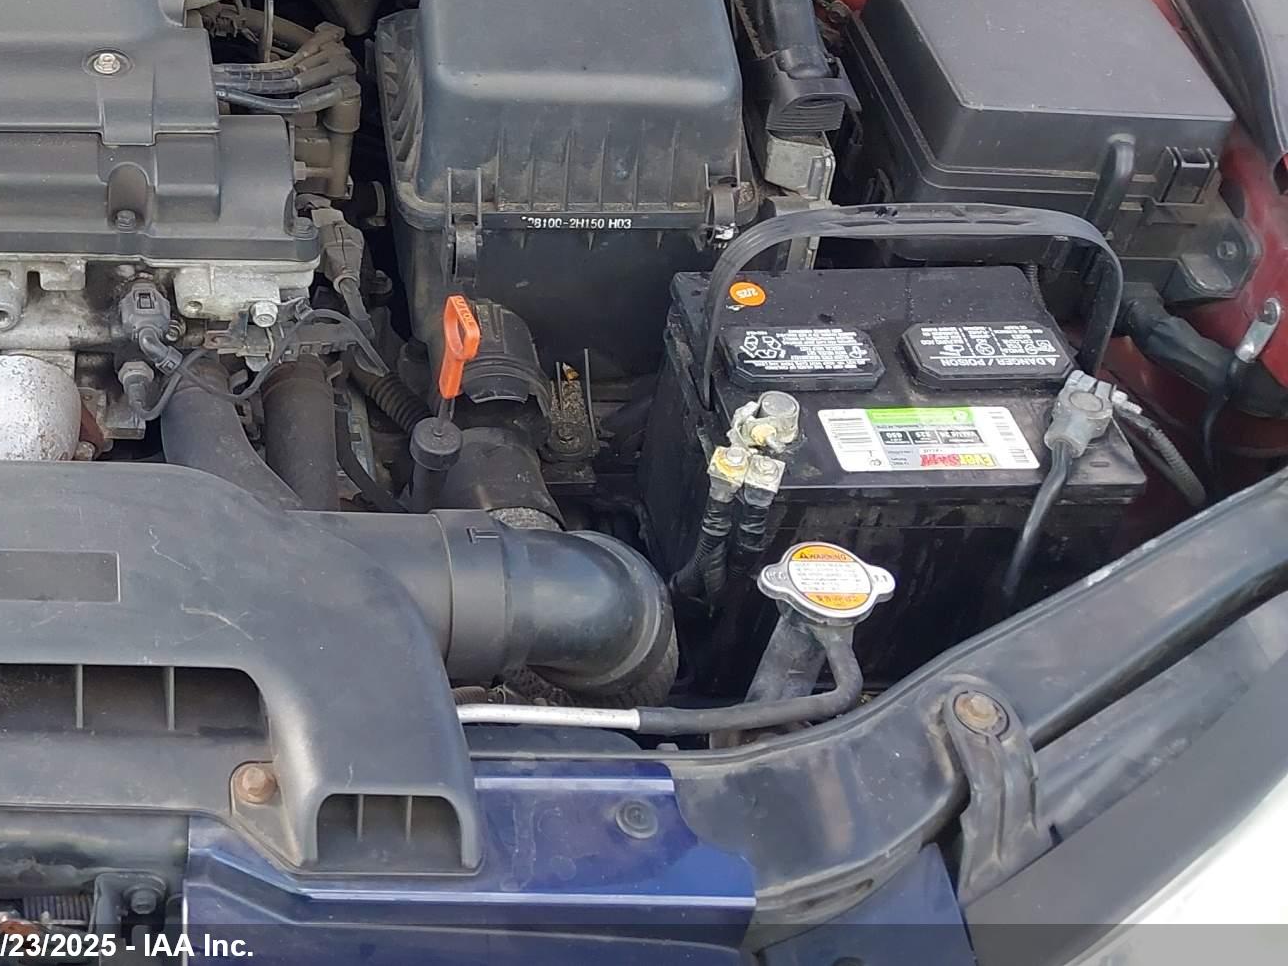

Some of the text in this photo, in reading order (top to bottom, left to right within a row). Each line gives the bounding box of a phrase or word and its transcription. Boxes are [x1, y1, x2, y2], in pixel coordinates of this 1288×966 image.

[608, 218, 632, 229] H03
[940, 358, 987, 367] POISON
[997, 358, 1048, 366] DANGER
